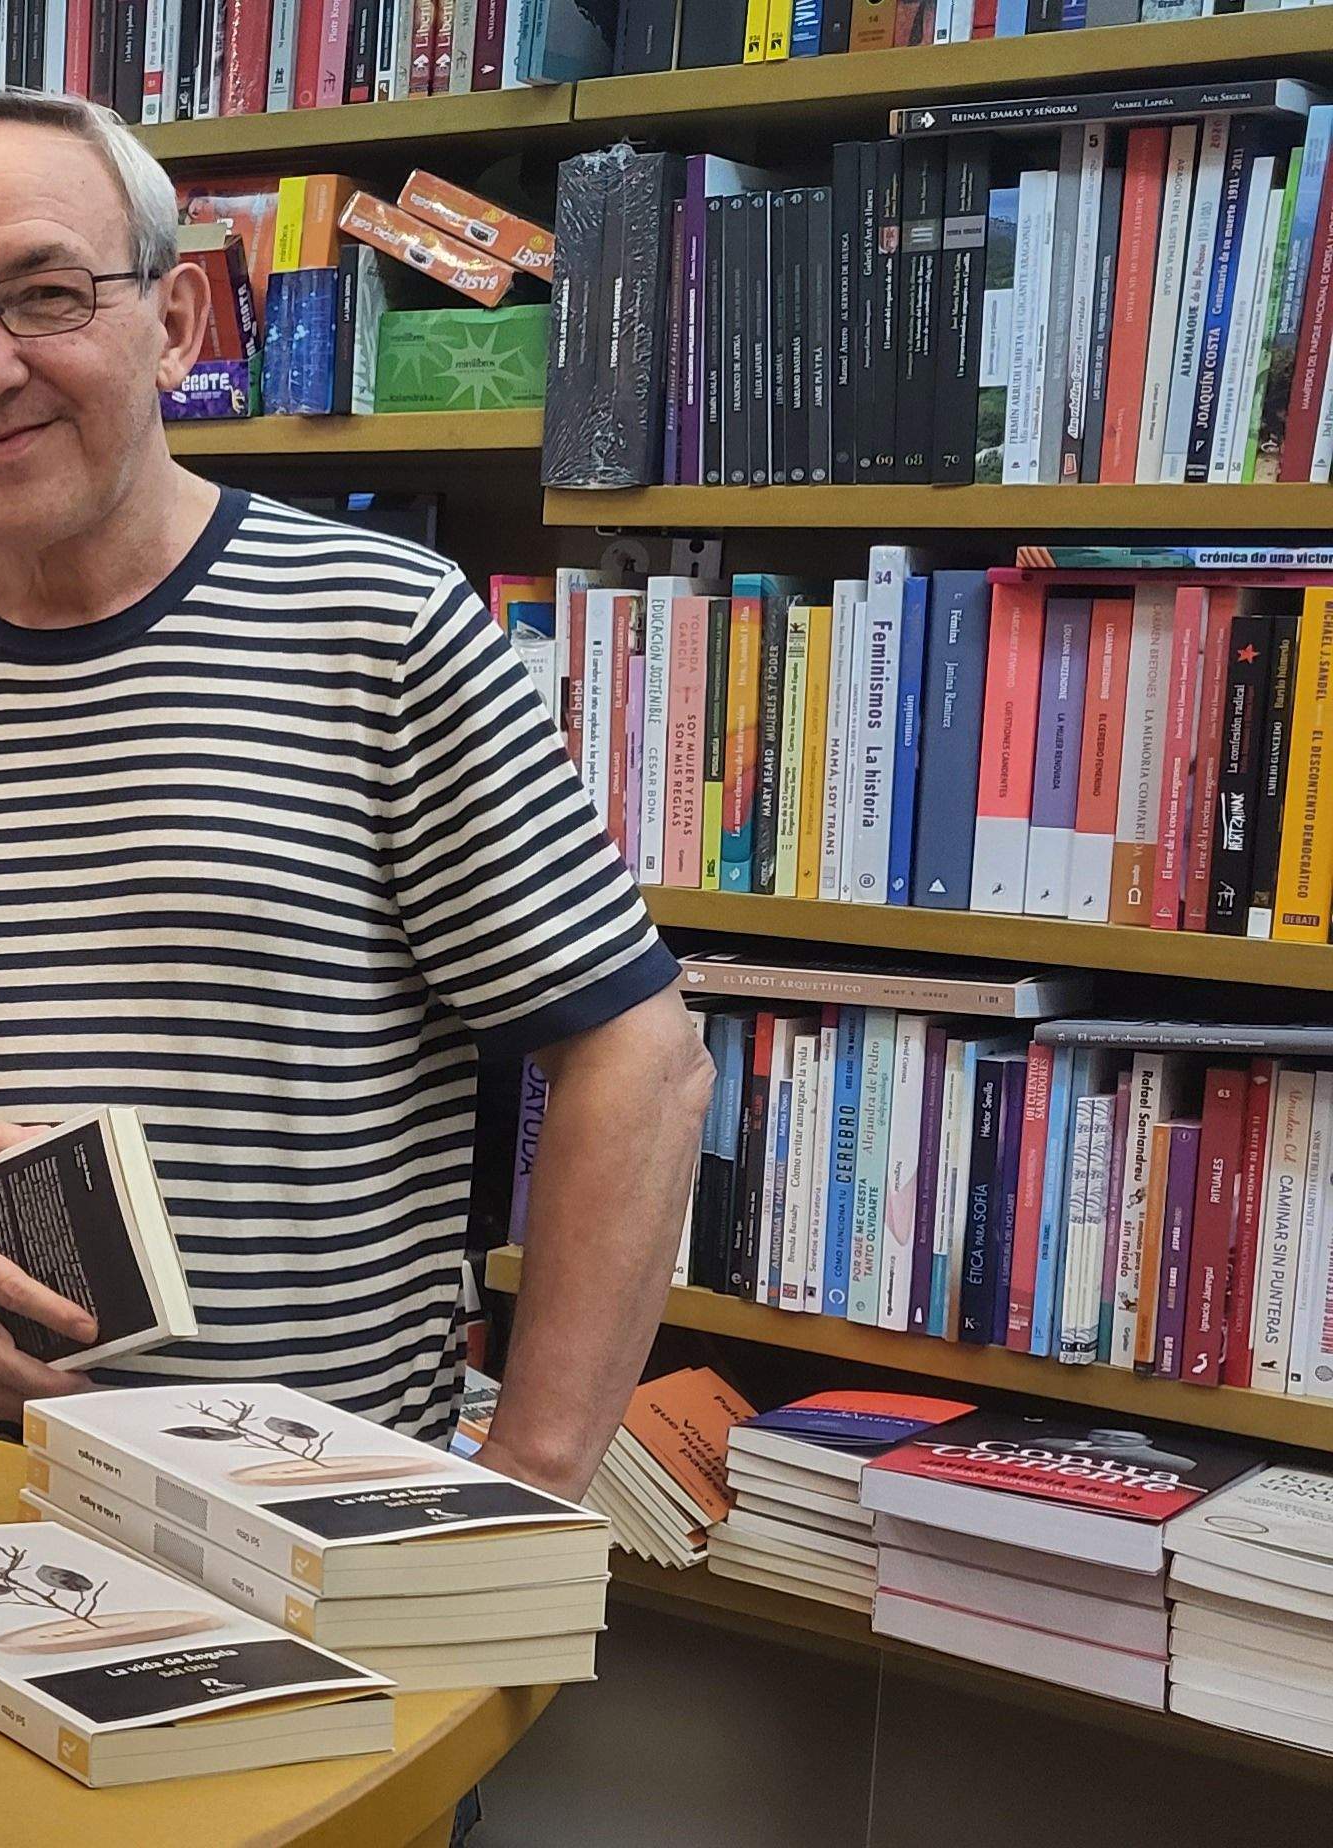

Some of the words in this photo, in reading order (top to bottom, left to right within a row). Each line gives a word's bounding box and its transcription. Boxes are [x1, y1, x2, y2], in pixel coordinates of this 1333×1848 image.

[328, 20, 338, 42] Piotr
[991, 109, 1023, 119] DAMAS
[1034, 105, 1077, 115] SEÑORAS
[1166, 228, 1178, 263] SISTEMA
[448, 269, 498, 289] BASKET
[1163, 267, 1173, 296] SOLAR
[559, 342, 567, 367] TODOS
[611, 342, 619, 367] TODOS
[733, 334, 742, 357] ARTIGA
[839, 327, 848, 352] Artero
[1180, 306, 1199, 377] ALMANAQUE
[1204, 328, 1221, 368] COSTA
[456, 358, 495, 369] minilibros
[754, 343, 763, 378] LAFUENTE
[838, 354, 849, 385] Manuel
[1195, 372, 1216, 429] JOAQUÍN
[1199, 552, 1248, 563] crónica
[1270, 554, 1293, 563] una
[874, 571, 892, 585] 34
[650, 600, 665, 660] EDUCACIÓN
[948, 610, 962, 643] Fémina
[767, 644, 779, 680] PODER
[867, 621, 893, 729] Feminismos
[944, 662, 959, 690] Janina
[571, 680, 583, 710] bebé
[648, 666, 662, 724] SOSTENIBLE
[675, 722, 685, 748] SON
[687, 714, 696, 738] SOY
[766, 696, 778, 741] MUJERES
[904, 695, 916, 746] comunión
[866, 746, 882, 764] La
[1096, 724, 1106, 756] CEREBRO
[1139, 725, 1153, 778] MEMORIA
[1228, 717, 1242, 760] confesión
[648, 748, 660, 786] CÉSAR
[674, 754, 684, 776] MIS
[685, 743, 695, 784] MUJER
[763, 749, 774, 782] BEARD
[1052, 750, 1063, 790] RENOVADA
[828, 785, 837, 808] SOY
[862, 769, 880, 827] historia
[1304, 746, 1321, 820] DESCONTENTO
[647, 790, 656, 824] BONA
[671, 781, 682, 827] REGLAS
[683, 800, 694, 836] ESTAS
[762, 786, 773, 817] MARY
[825, 814, 836, 855] TRANS
[1297, 825, 1315, 898] DEMOCRÁTICO
[738, 975, 776, 986] TAROT
[1139, 1071, 1153, 1108] Rafael
[863, 1098, 877, 1154] Alejandra
[836, 1105, 856, 1183] CEREBRO
[1133, 1113, 1151, 1181] Santandreu
[865, 1186, 878, 1241] OLVIDARTE
[971, 1184, 988, 1221] SOFÍA
[1274, 1175, 1294, 1240] CAMINAR
[835, 1204, 845, 1248] FUNCIONA
[771, 1223, 782, 1268] ARMONÍA
[864, 1244, 874, 1276] TANTO
[966, 1250, 984, 1284] ÉTICA
[1265, 1270, 1285, 1343] PUNTERAS
[78, 1449, 95, 1465] Ángela
[96, 1459, 102, 1467] de
[104, 1463, 114, 1472] vida
[115, 1468, 121, 1477] La
[931, 1444, 1176, 1493] Corriente
[976, 1440, 1181, 1486] Contra
[358, 1493, 386, 1504] vida
[408, 1486, 460, 1499] Ángela
[103, 1508, 114, 1518] vida
[115, 1514, 121, 1523] La
[250, 1536, 260, 1547] Sol
[106, 1667, 130, 1678] La
[132, 1662, 165, 1676] vida
[190, 1648, 239, 1666] Ángela
[188, 1662, 218, 1676] Otto
